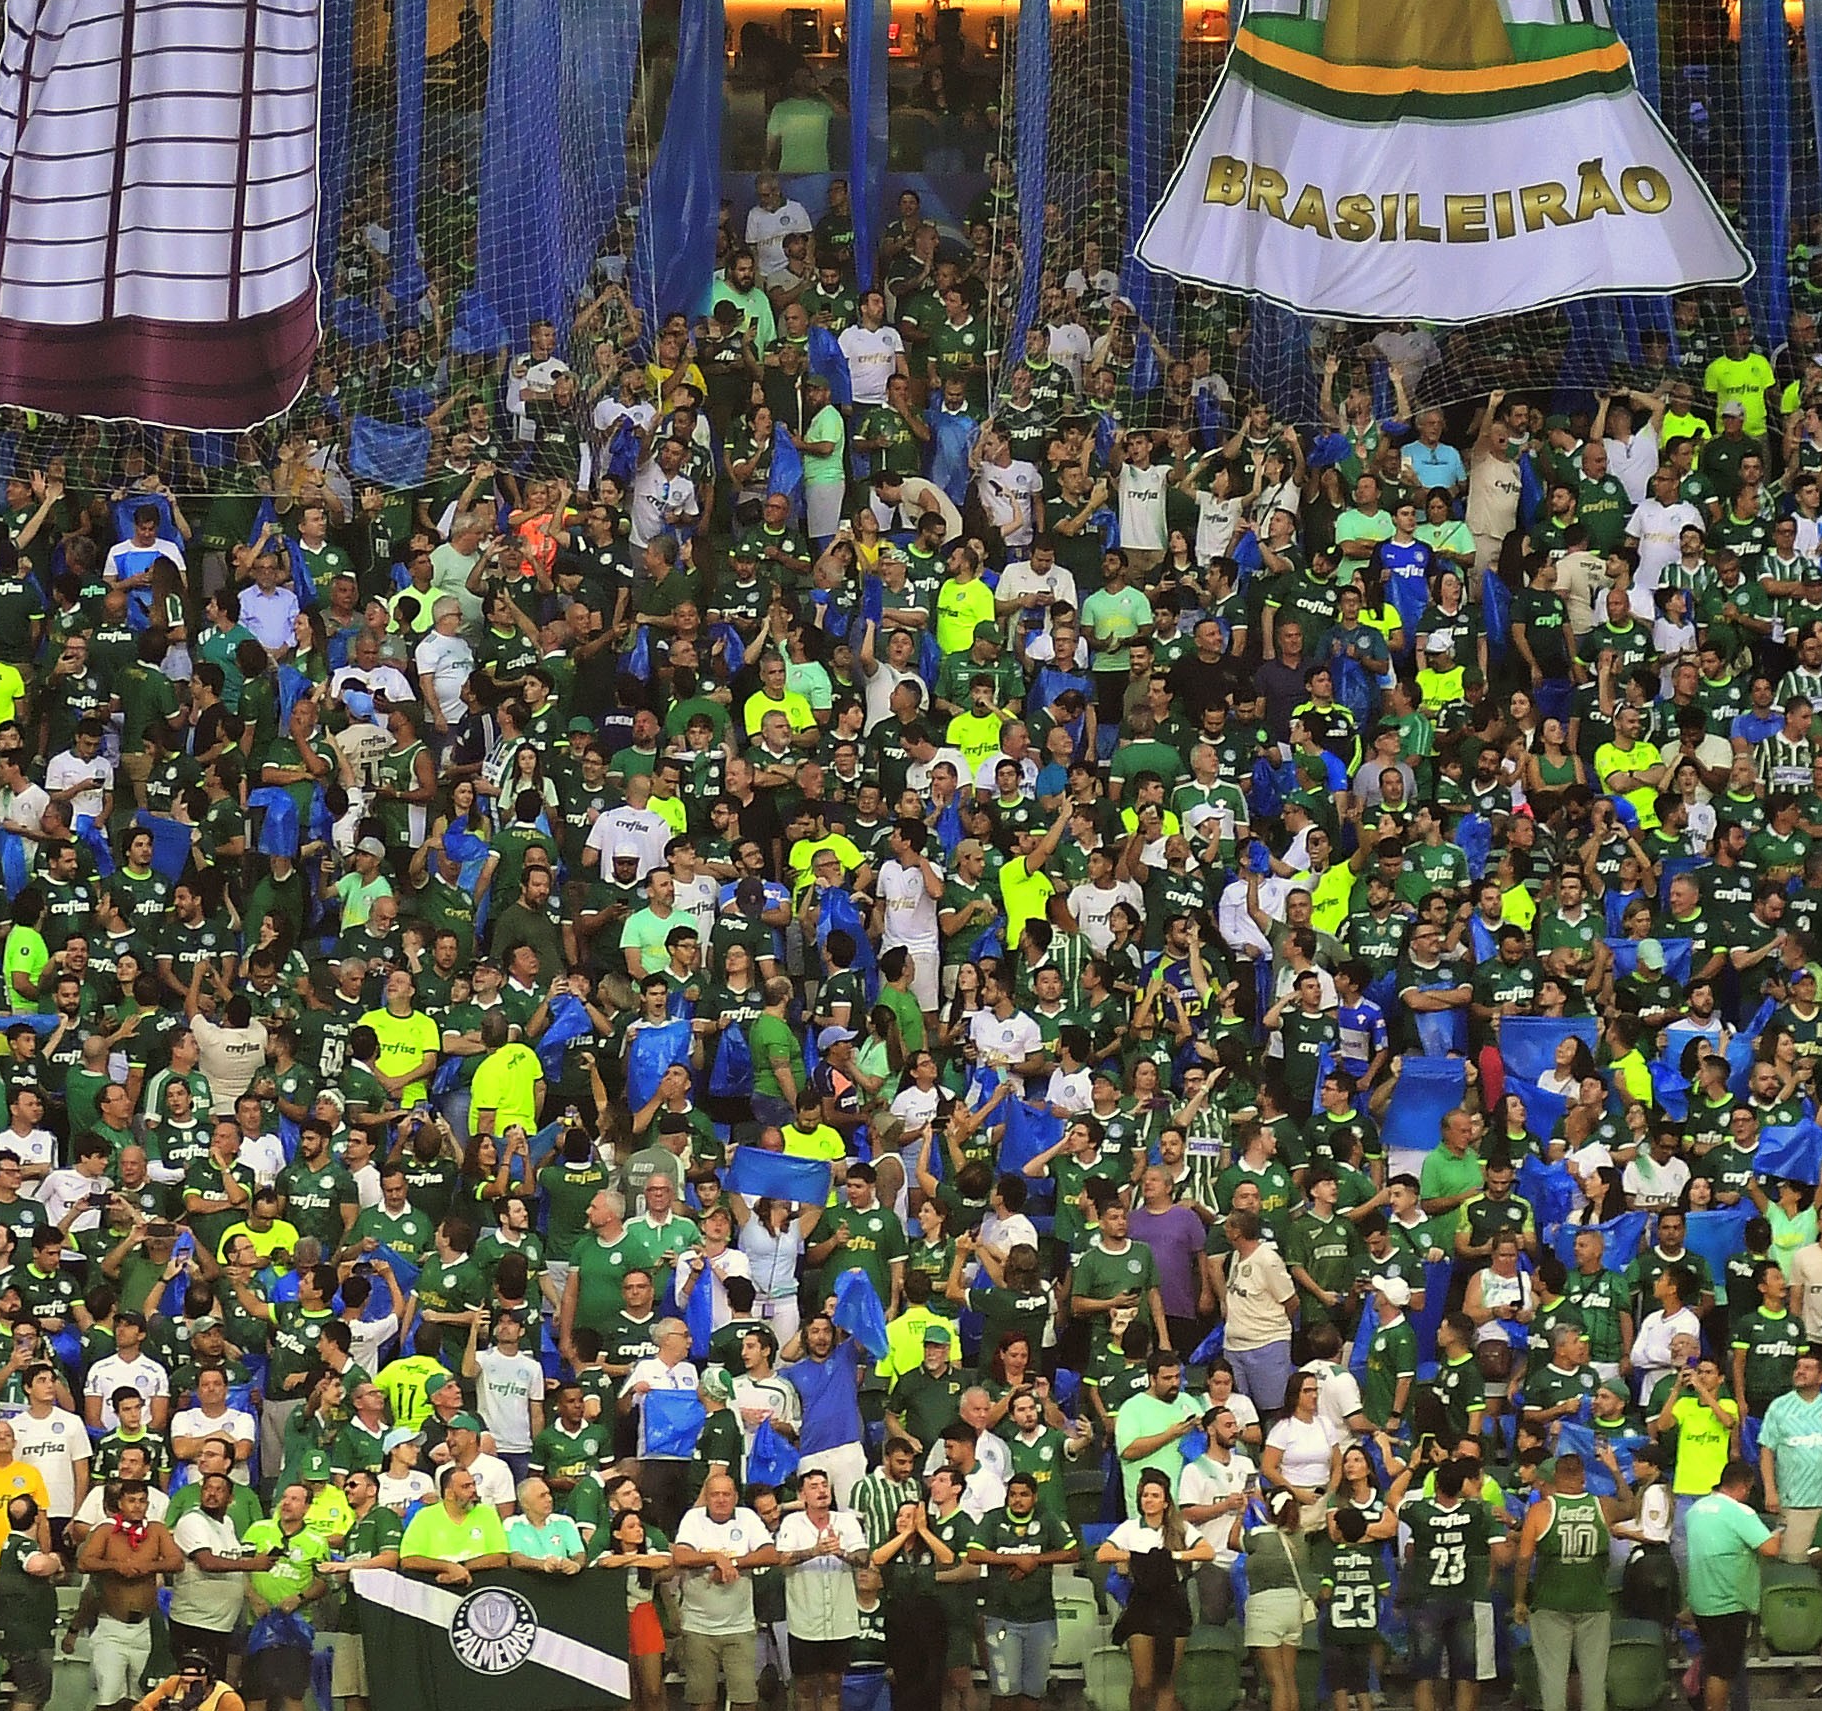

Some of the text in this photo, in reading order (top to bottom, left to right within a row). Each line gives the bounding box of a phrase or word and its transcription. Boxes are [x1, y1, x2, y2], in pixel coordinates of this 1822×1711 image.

[1202, 154, 1674, 245] BRASILEIRÃO
[858, 353, 892, 365] crefisa
[1129, 490, 1157, 500] crefisa
[1297, 599, 1335, 616] crefisa
[96, 629, 131, 642] crefisa
[965, 745, 998, 756] crefisa
[616, 819, 649, 831] crefisa
[1166, 890, 1203, 907] crefisa
[1714, 887, 1752, 901] crefisa
[50, 900, 89, 916] crefisa
[1359, 943, 1399, 958] crefisa
[1493, 987, 1533, 1003] crefisa
[720, 1007, 761, 1022] crefisa
[226, 1043, 259, 1054] crefisa
[168, 1144, 211, 1160] crefisa
[565, 1170, 602, 1184] crefisa
[289, 1195, 329, 1210] crefisa
[1756, 1341, 1809, 1357] crefisa
[489, 1383, 526, 1396] crefisa
[23, 1444, 65, 1459] crefisa
[1558, 1521, 1599, 1564] 10
[1334, 1554, 1372, 1568] crefisa
[1428, 1544, 1468, 1586] 23
[1330, 1585, 1375, 1628] 23
[453, 1621, 537, 1671] PALMEIRAS
